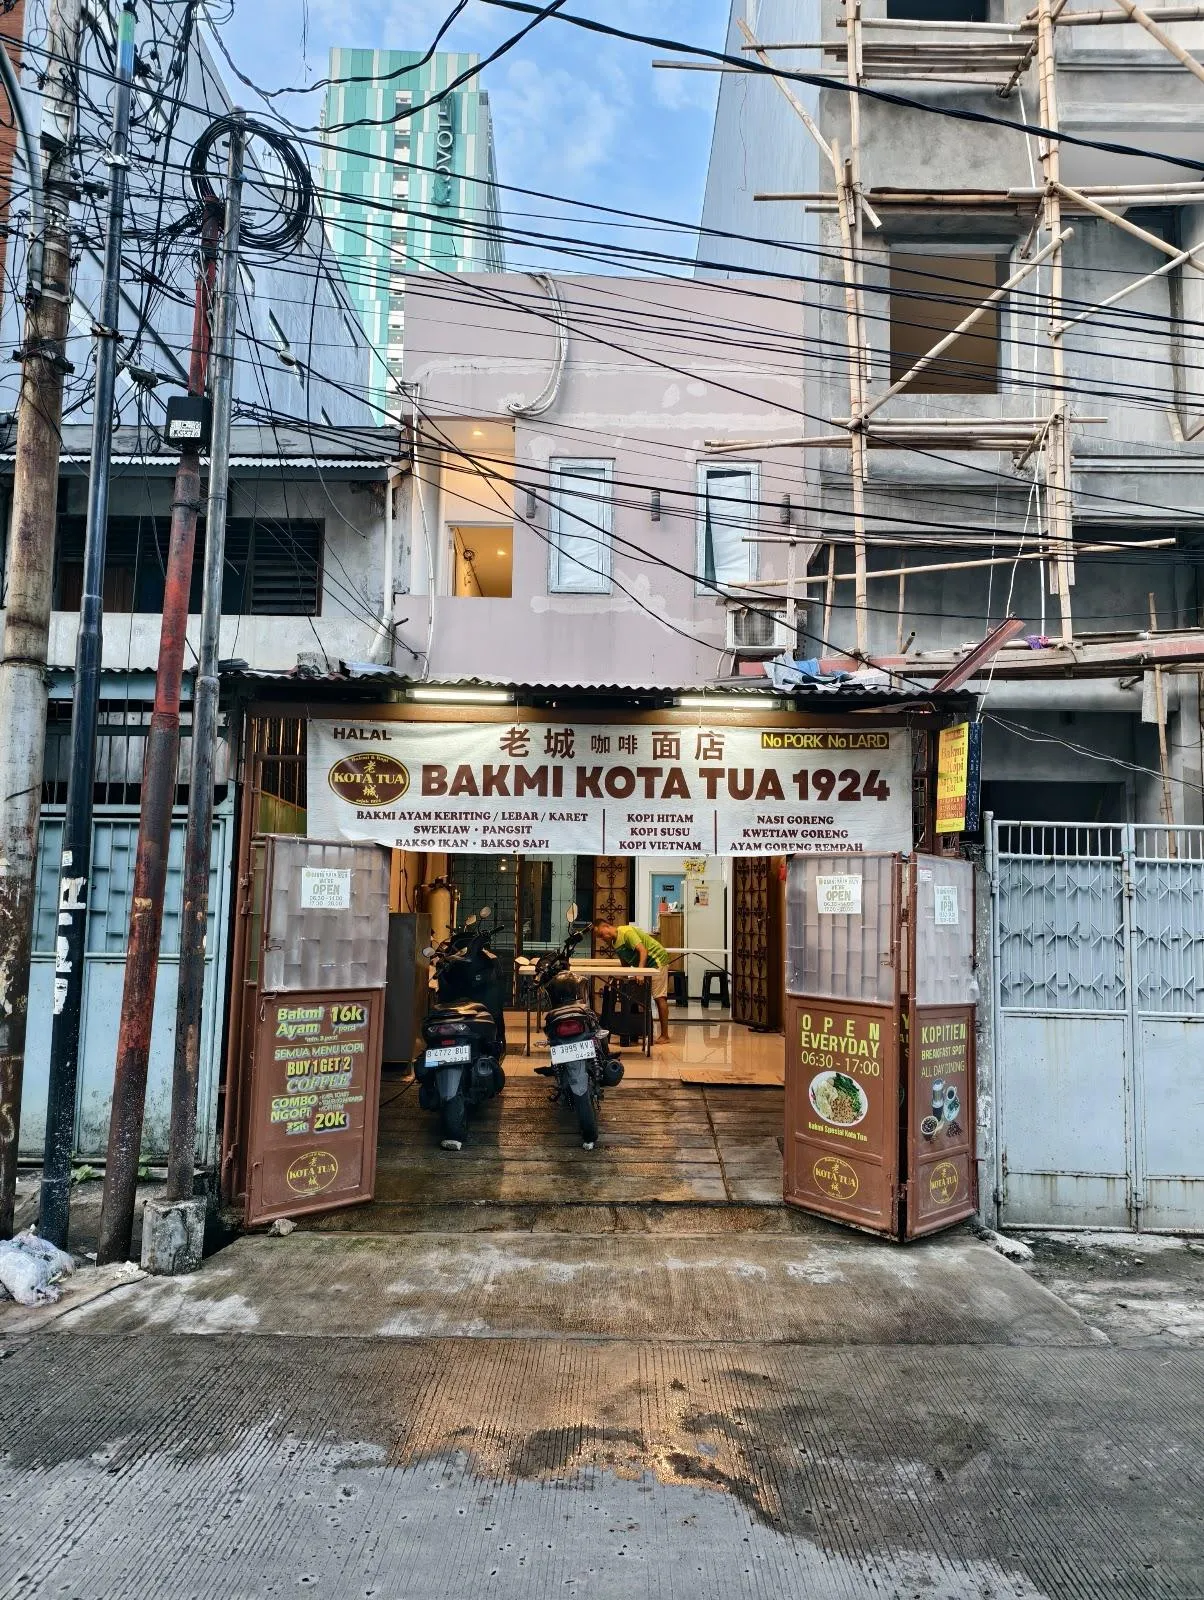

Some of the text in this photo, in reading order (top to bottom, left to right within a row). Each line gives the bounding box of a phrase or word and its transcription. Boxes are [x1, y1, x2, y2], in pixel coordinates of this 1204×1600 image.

[333, 727, 392, 741] HALAL
[763, 733, 888, 749] No PORK No LARD
[500, 728, 726, 760] 老城咖啡面店
[334, 772, 404, 785] KOTA TUA
[421, 764, 890, 801] BAKMI KOTA TUA 1924
[356, 810, 588, 822] BAKMI AYAM KERITING / LEBAR / KARET
[627, 813, 694, 823] KOPI HITAM
[757, 815, 834, 825] NASI GORENG
[413, 825, 533, 835] SWEKIAW PANGSIT
[630, 827, 690, 837] KOPI SUSU
[742, 828, 849, 839] KWETIAW GORENG
[396, 838, 549, 849] BAKSO IKAN BAKSO SAPI
[619, 841, 702, 851] KOPI VIETNAM
[730, 842, 863, 852] AYAM GORENG REMPAH
[312, 884, 340, 896] OPEN
[826, 890, 852, 901] OPEN
[277, 1006, 324, 1021] Bakmi
[331, 1005, 363, 1022] 16k
[276, 1022, 319, 1039] Ayam
[802, 1014, 880, 1040] OPEN
[274, 1043, 364, 1060] SEMUA MENU KOPI
[551, 1047, 557, 1056] B
[801, 1031, 880, 1058] EVERYDAY
[426, 1050, 432, 1058] B
[287, 1056, 351, 1076] BUY 1 GET 2
[801, 1050, 833, 1068] 06:30
[845, 1058, 880, 1077] 17:00
[921, 1066, 933, 1078] ALL
[271, 1094, 317, 1109] COMBO
[314, 1111, 346, 1129] 20k
[289, 1163, 336, 1179] KOTA TUA
[815, 1167, 856, 1187] KOTA TUA
